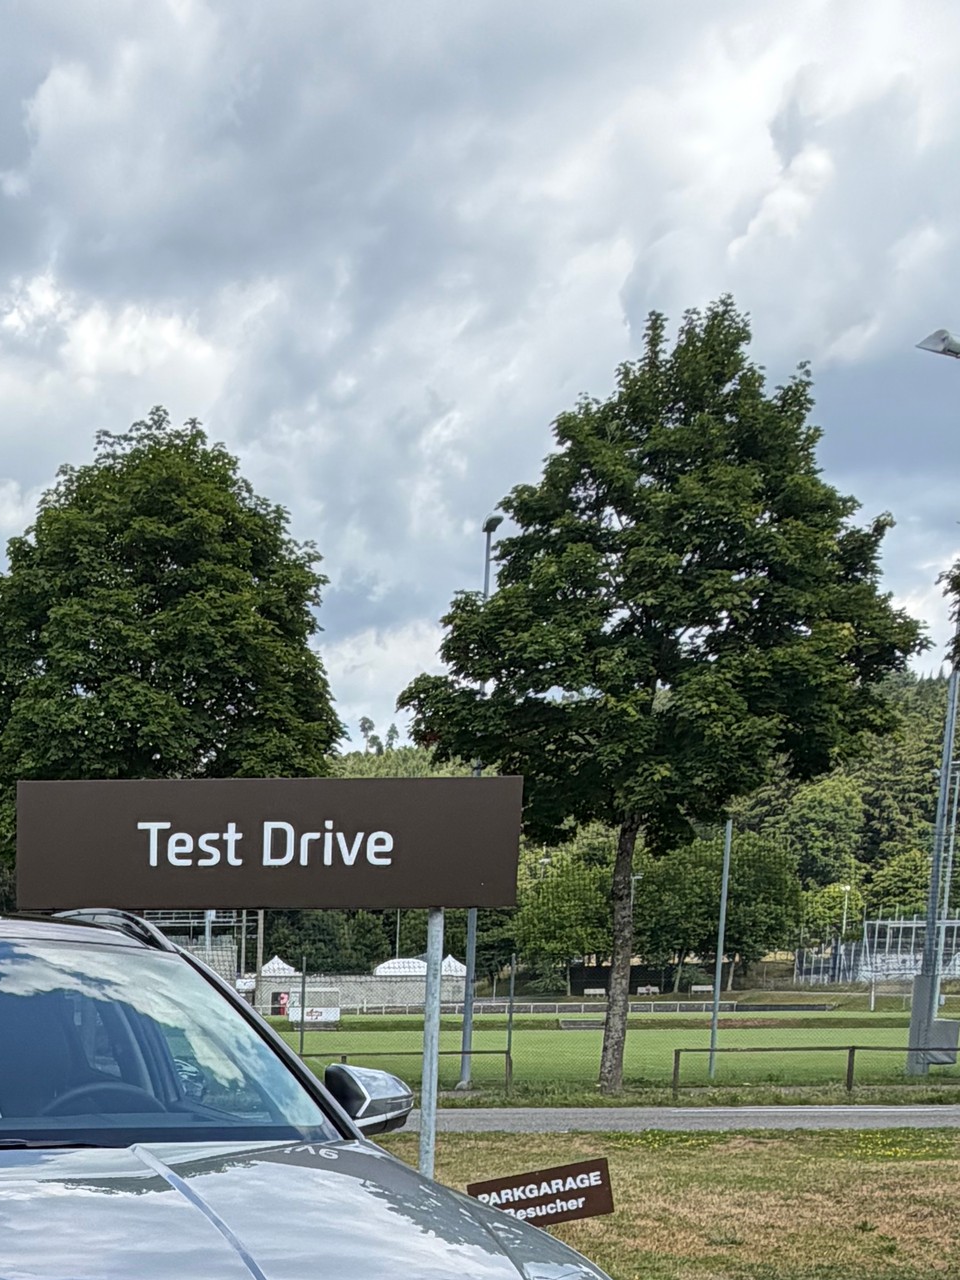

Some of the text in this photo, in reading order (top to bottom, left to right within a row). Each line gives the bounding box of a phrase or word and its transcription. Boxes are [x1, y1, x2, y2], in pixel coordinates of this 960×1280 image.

[137, 820, 394, 866] Test Drive
[477, 1171, 603, 1206] PARKGARAGE
